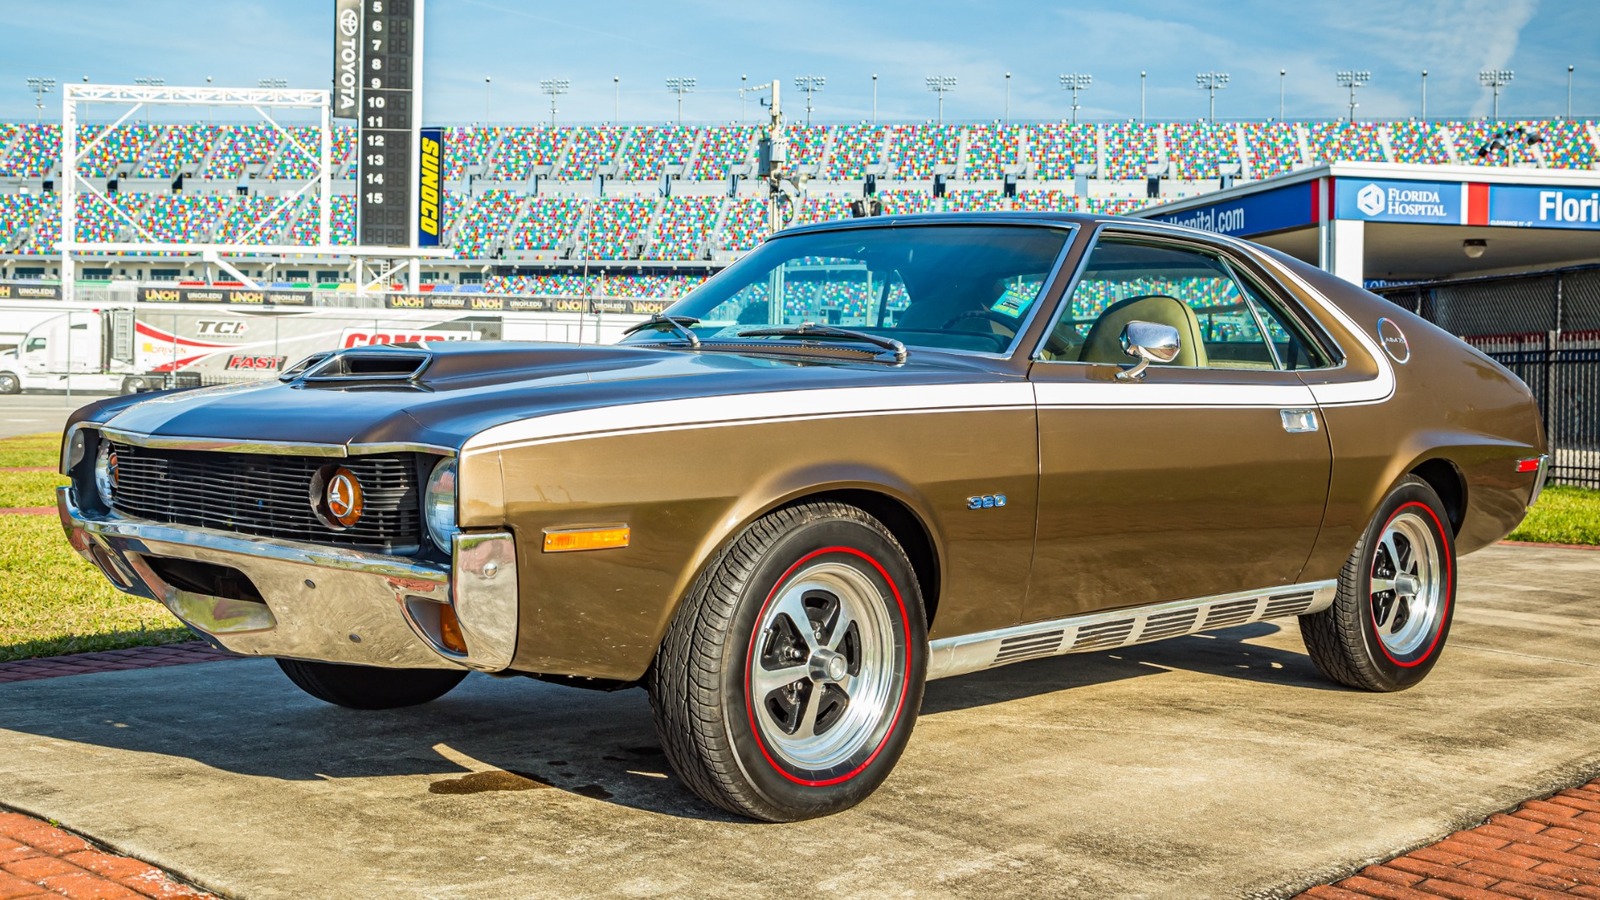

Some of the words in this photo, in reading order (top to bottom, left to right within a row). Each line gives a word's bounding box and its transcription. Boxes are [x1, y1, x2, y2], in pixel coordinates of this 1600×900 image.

[372, 1, 382, 12] 5
[372, 20, 382, 32] 6
[372, 39, 381, 51] 7
[371, 58, 381, 70] 8
[341, 38, 356, 109] TOYOTA
[371, 77, 380, 89] 9
[367, 97, 385, 108] 10
[367, 116, 383, 128] 11
[367, 135, 384, 147] 12
[367, 154, 384, 166] 13
[366, 173, 384, 184] 14
[421, 136, 440, 236] SUNOCO
[366, 192, 383, 204] 15
[1388, 188, 1440, 203] FLORIDA
[1387, 202, 1447, 216] HOSPITAL
[1540, 191, 1600, 223] Flori
[145, 290, 180, 302] UNOH
[229, 292, 264, 304] UNOH
[392, 296, 425, 308] UNOH
[471, 298, 503, 309] UNOH
[557, 301, 588, 312] UNOH
[633, 303, 663, 314] UNOH
[230, 356, 281, 369] FAST
